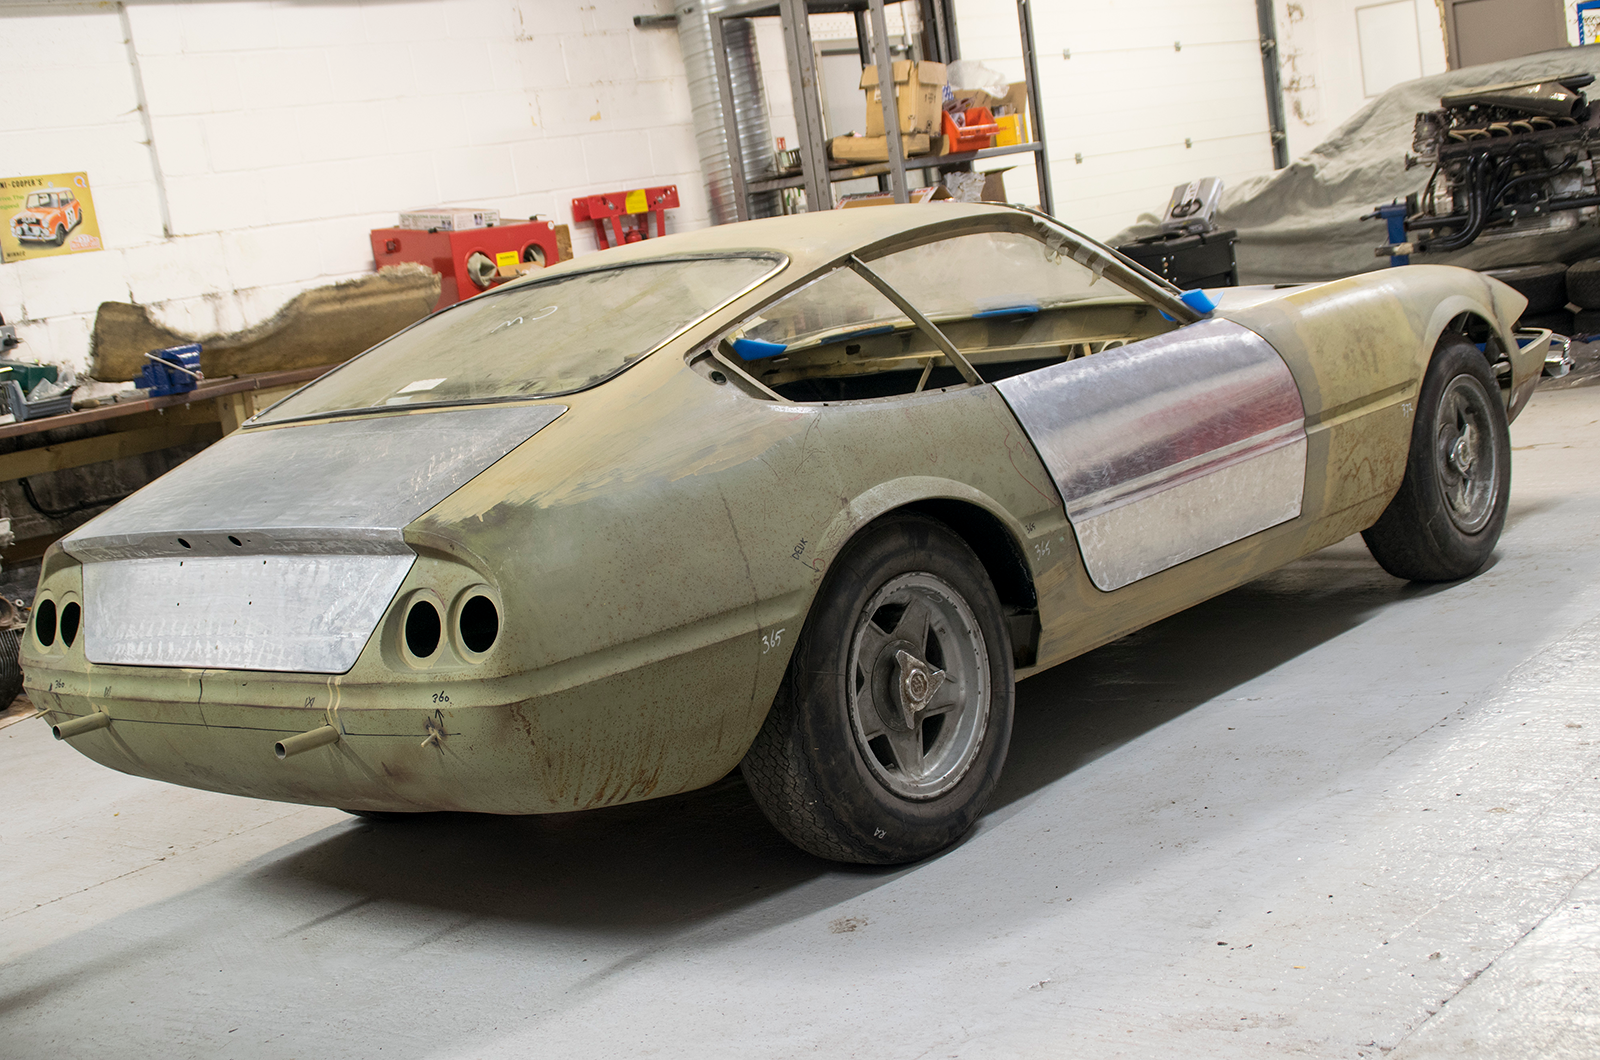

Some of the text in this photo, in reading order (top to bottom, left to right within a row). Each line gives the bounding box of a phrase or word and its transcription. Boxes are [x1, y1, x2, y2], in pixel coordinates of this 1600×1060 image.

[1025, 522, 1036, 534] 365
[1035, 540, 1051, 561] 365
[762, 628, 786, 655] 365
[431, 690, 450, 704] 360
